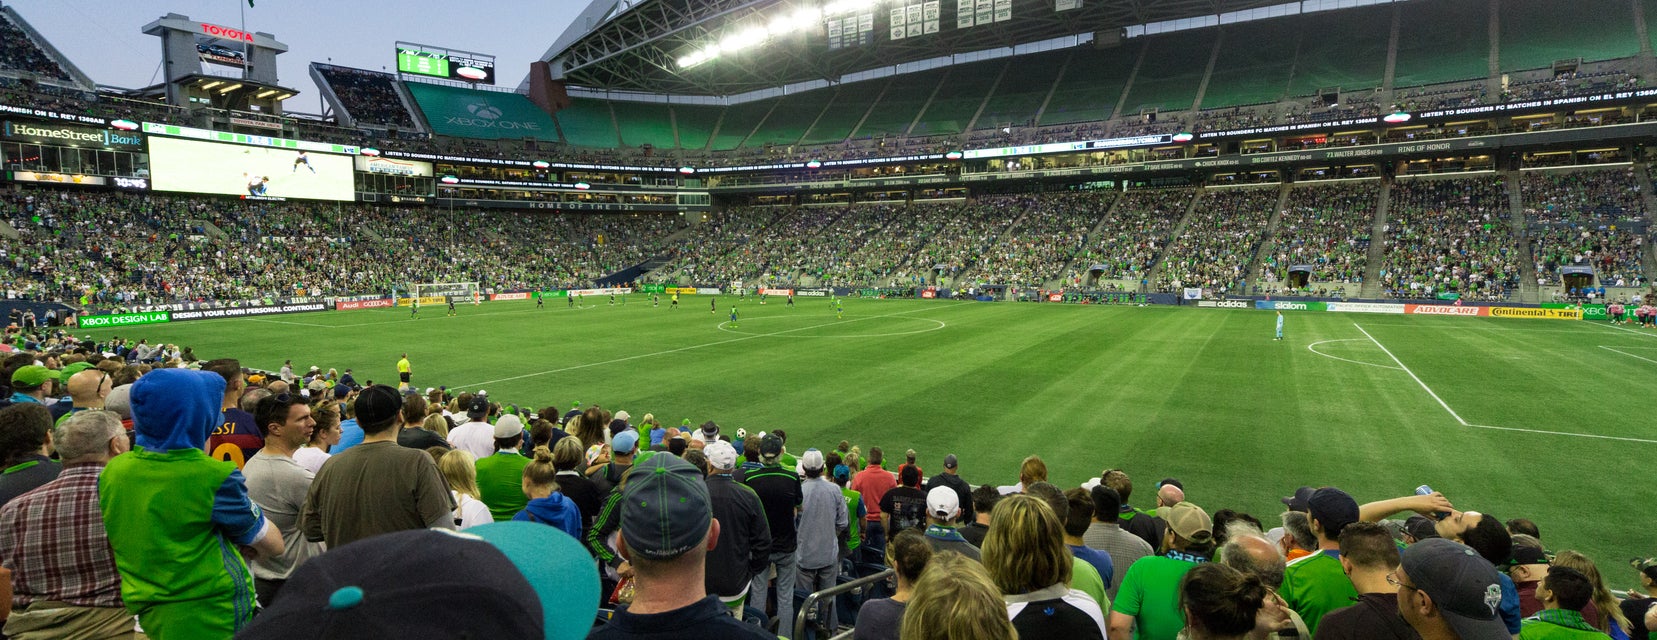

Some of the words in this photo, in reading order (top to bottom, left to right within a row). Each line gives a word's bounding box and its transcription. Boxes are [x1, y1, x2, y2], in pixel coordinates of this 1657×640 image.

[200, 23, 254, 42] TOYOTA
[1456, 106, 1493, 115] SOUNDERS
[1507, 101, 1541, 110] MATCHES
[1553, 97, 1587, 106] SPANISH
[444, 116, 496, 128] XBOX
[498, 120, 542, 131] ONE
[111, 134, 141, 145] Bank
[1426, 143, 1450, 151] HONOR
[172, 311, 200, 319] DESIGN
[247, 306, 282, 314] PERSONAL
[283, 304, 324, 313] CONTROLLER
[1275, 301, 1306, 310] slalom
[1413, 305, 1478, 315] ADVOCARE
[1582, 307, 1606, 316] XBO
[1492, 308, 1546, 317] Continental
[82, 316, 111, 326] XBOX
[112, 314, 145, 325] DESIGN
[152, 313, 168, 322] LAB
[212, 422, 236, 435] SSI
